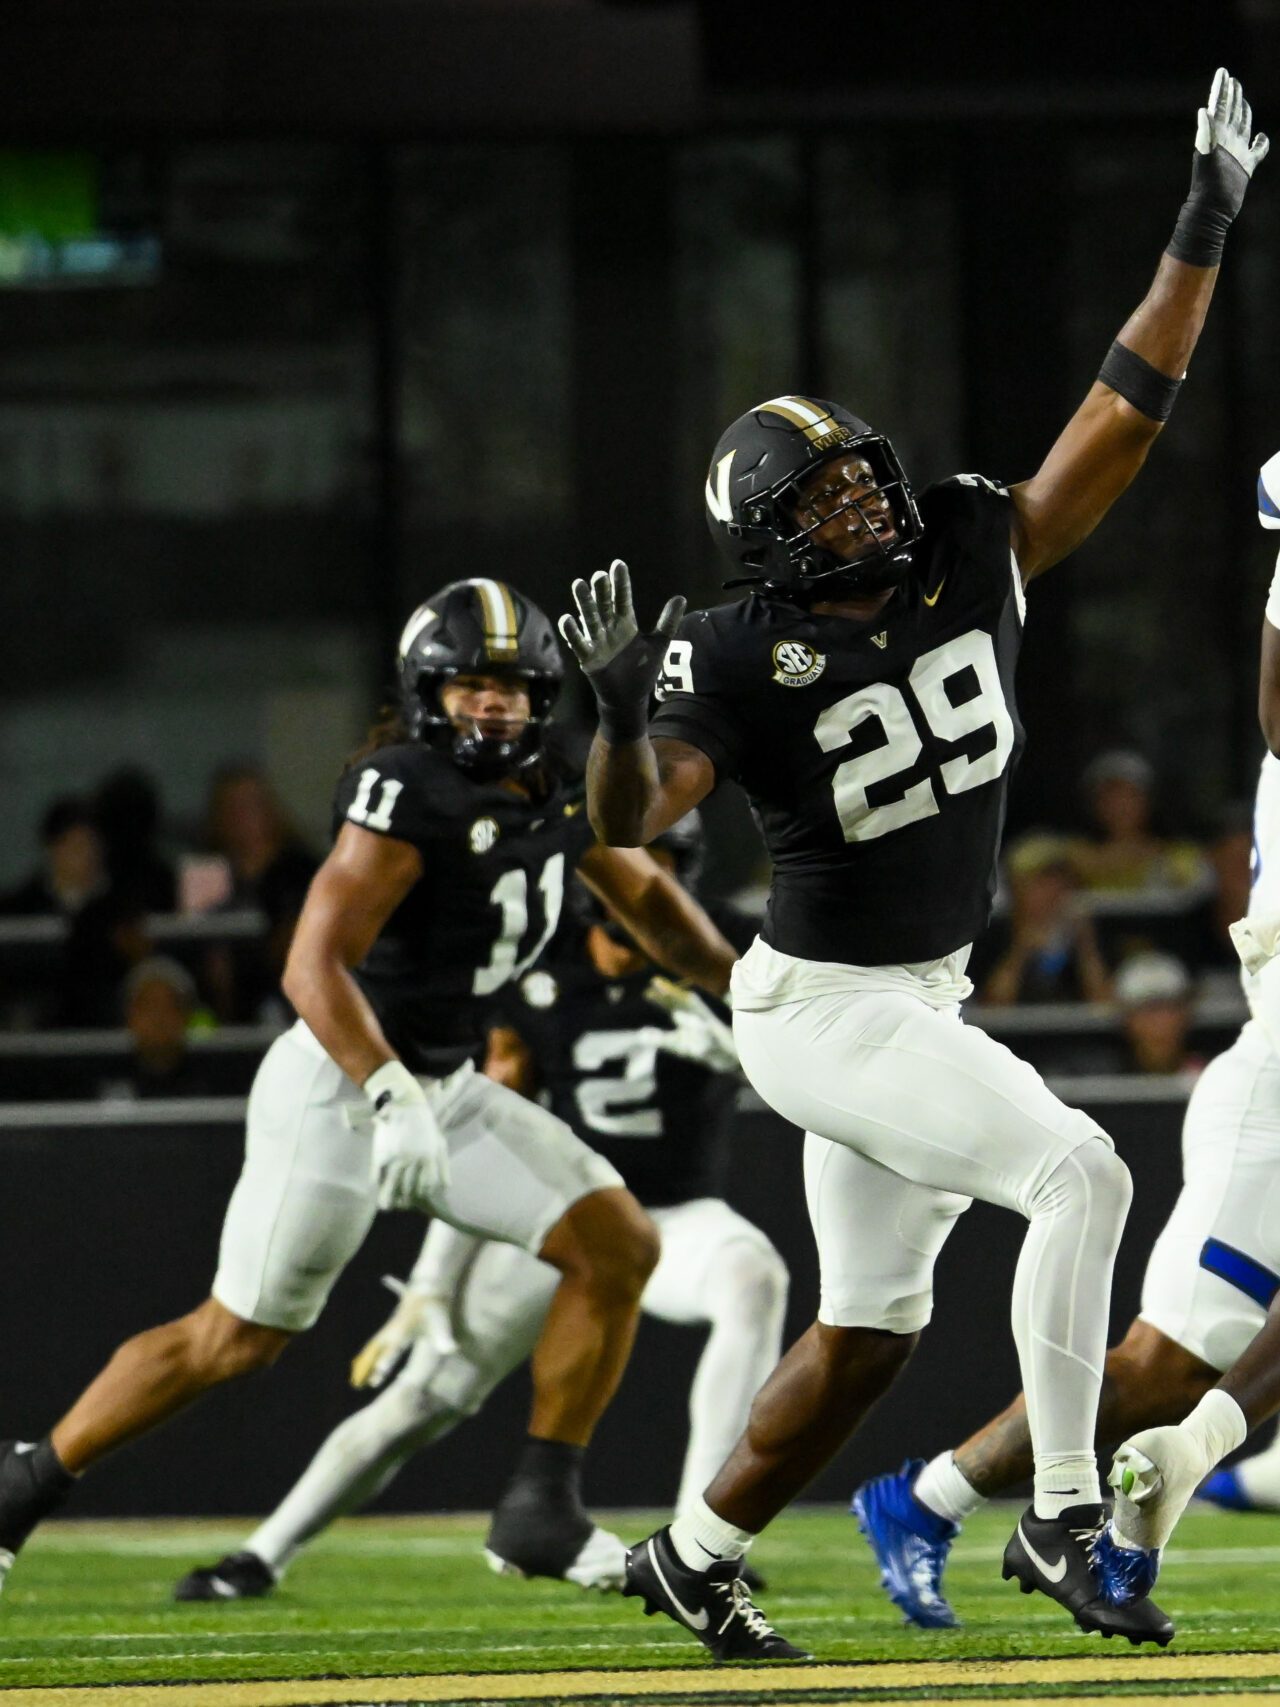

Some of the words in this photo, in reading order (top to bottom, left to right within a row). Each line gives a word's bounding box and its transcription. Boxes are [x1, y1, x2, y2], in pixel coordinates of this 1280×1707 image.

[655, 640, 695, 702] 9
[776, 643, 813, 674] SEC
[783, 662, 824, 685] GRADUATE
[813, 629, 1015, 843] 29
[346, 768, 405, 832] 11
[471, 851, 565, 997] 11
[572, 1028, 665, 1137] 2
